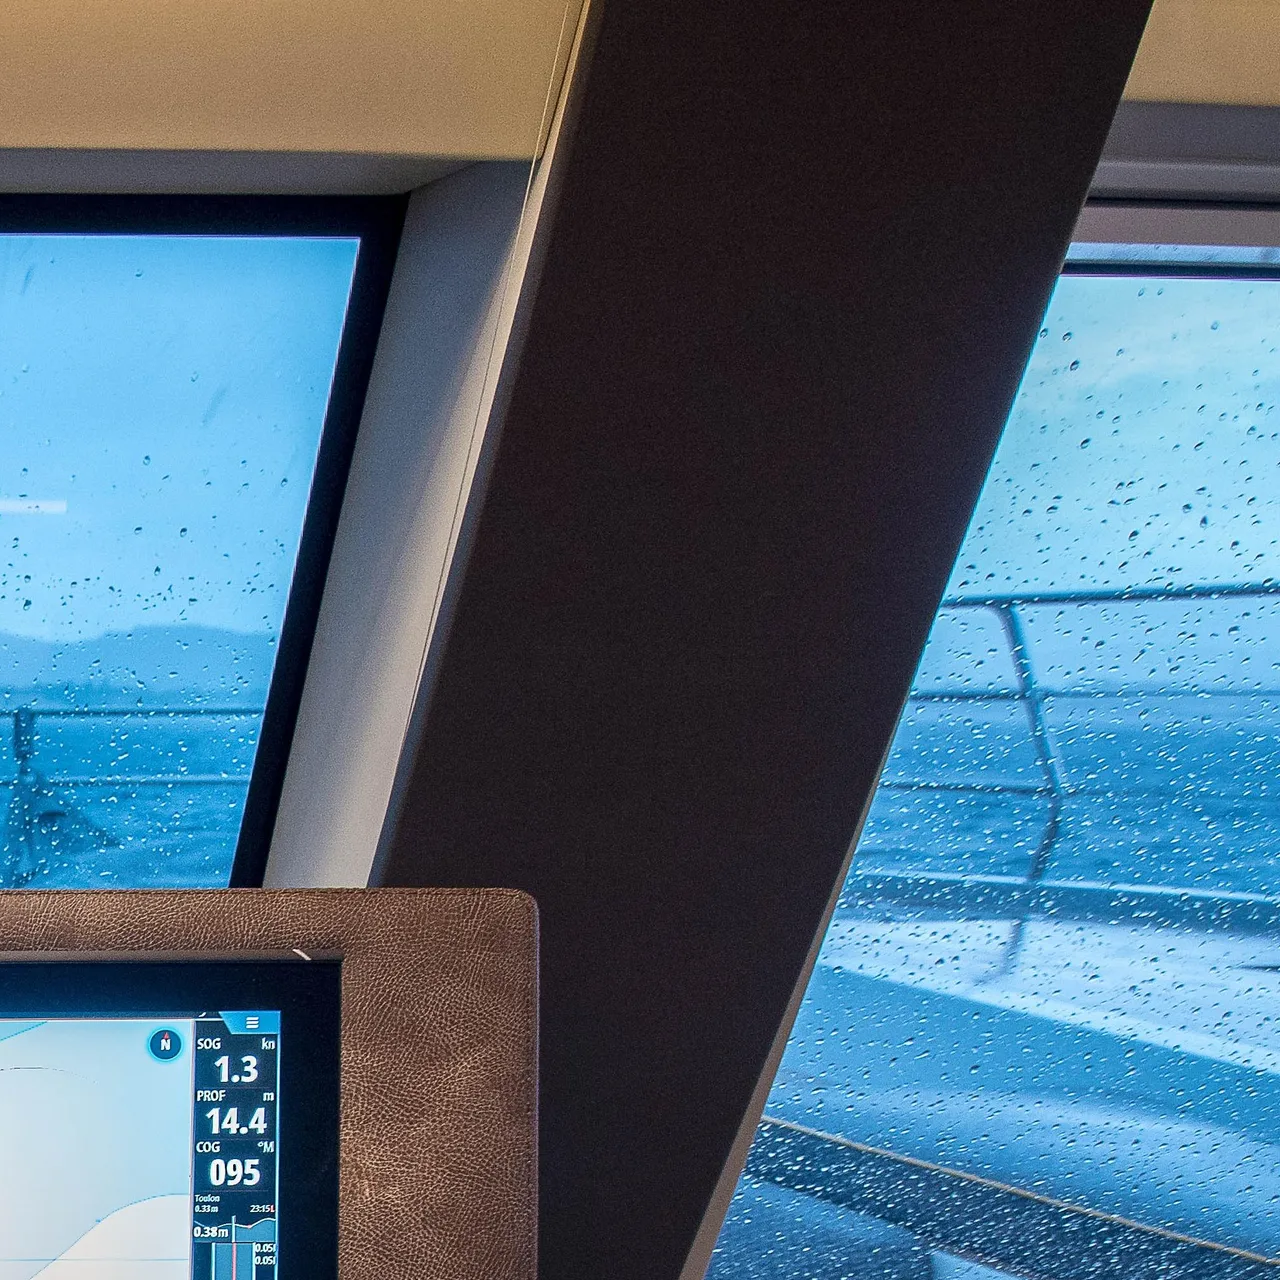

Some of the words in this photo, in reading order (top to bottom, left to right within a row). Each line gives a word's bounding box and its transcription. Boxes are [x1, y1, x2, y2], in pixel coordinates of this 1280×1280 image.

[160, 1039, 171, 1051] N
[197, 1038, 221, 1050] SOG
[261, 1037, 275, 1050] kn
[214, 1055, 259, 1083] 1.3
[196, 1090, 226, 1102] PROF
[263, 1092, 274, 1102] m
[206, 1107, 268, 1135] 14.4
[196, 1141, 220, 1153] COG
[257, 1140, 274, 1153] °M
[209, 1158, 260, 1186] 095
[194, 1194, 220, 1203] Toulon
